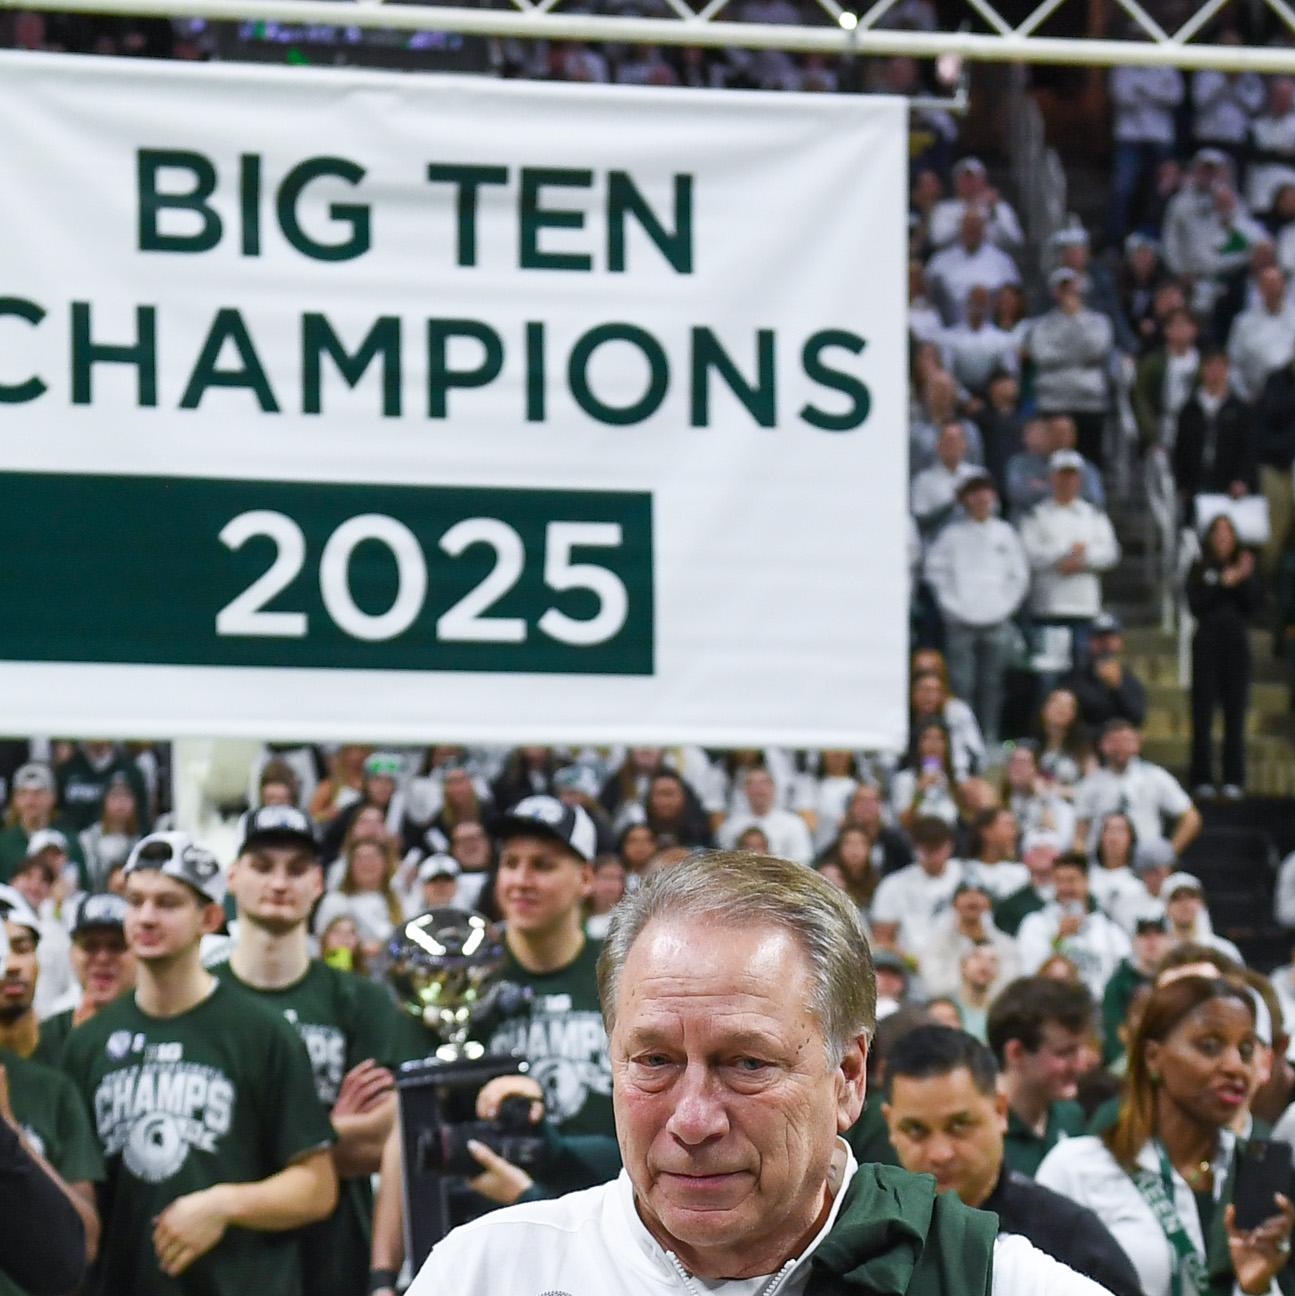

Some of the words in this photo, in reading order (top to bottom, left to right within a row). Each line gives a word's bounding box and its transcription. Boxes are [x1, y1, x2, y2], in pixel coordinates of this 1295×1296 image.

[137, 148, 373, 261] BIG
[428, 163, 695, 275] TEN
[215, 508, 630, 648] 2025
[94, 1070, 235, 1137] CHAMPS
